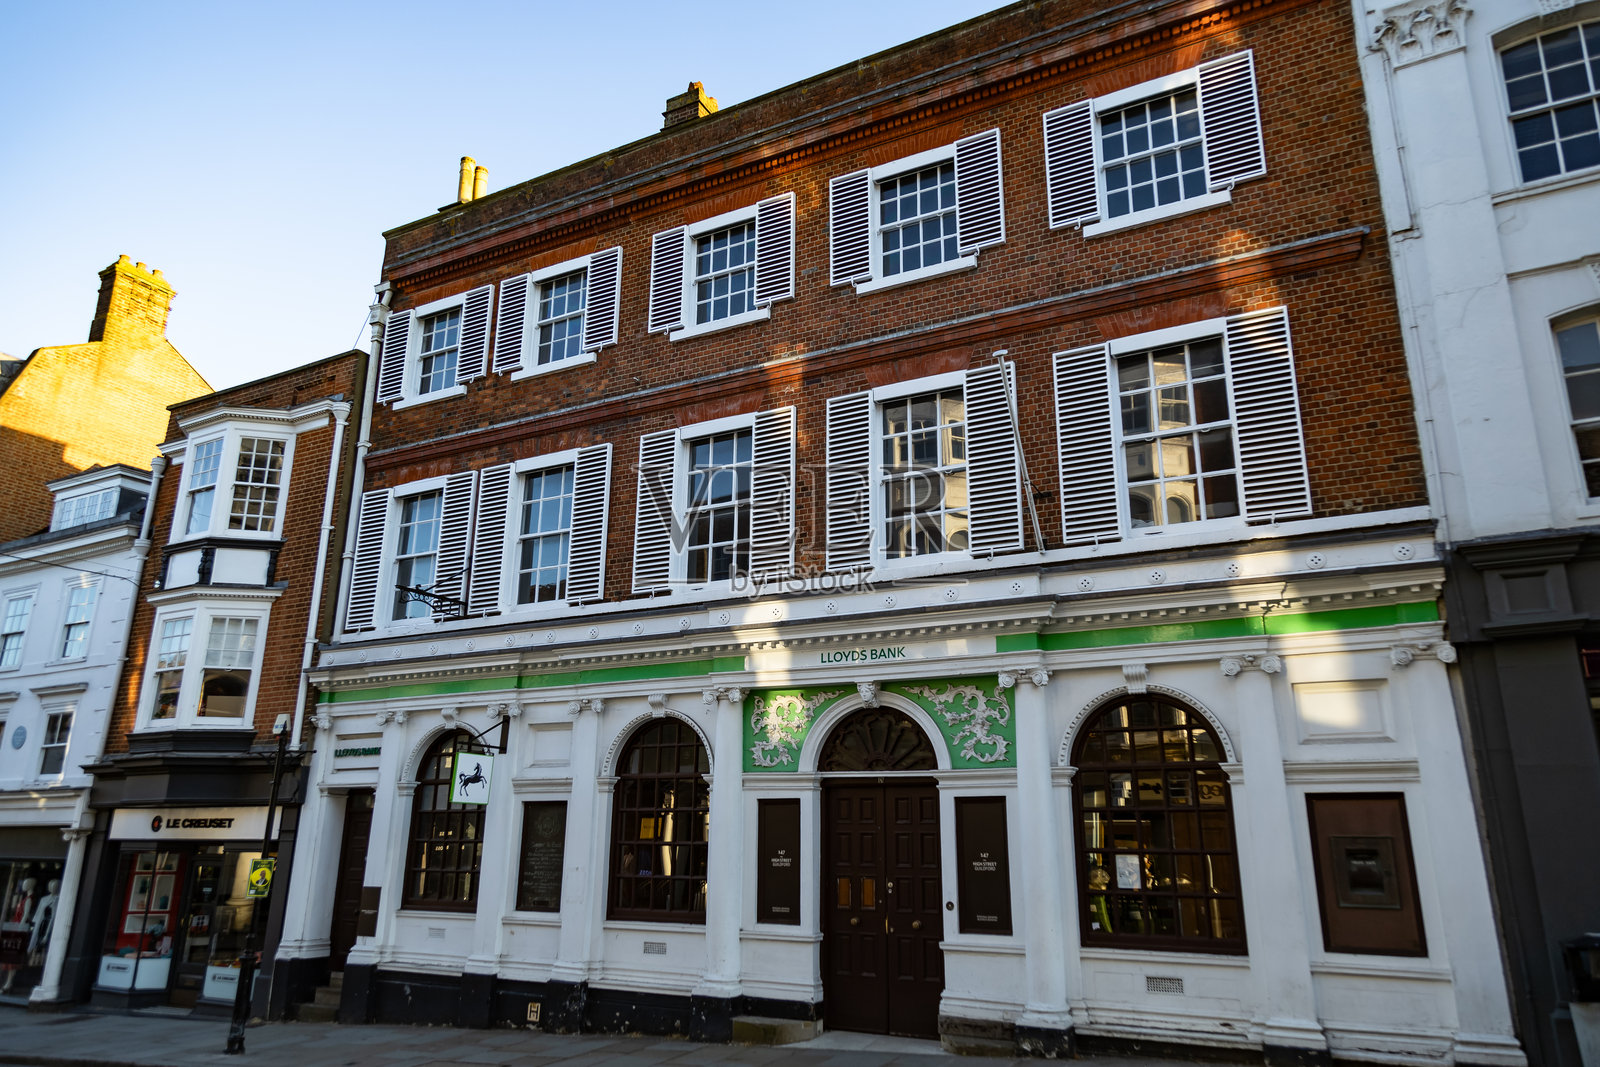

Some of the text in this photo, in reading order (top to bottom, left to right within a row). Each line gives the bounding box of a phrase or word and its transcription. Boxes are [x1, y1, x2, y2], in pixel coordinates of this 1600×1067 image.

[820, 646, 906, 664] LLOYDS BANK
[166, 818, 235, 829] LE CREUSET
